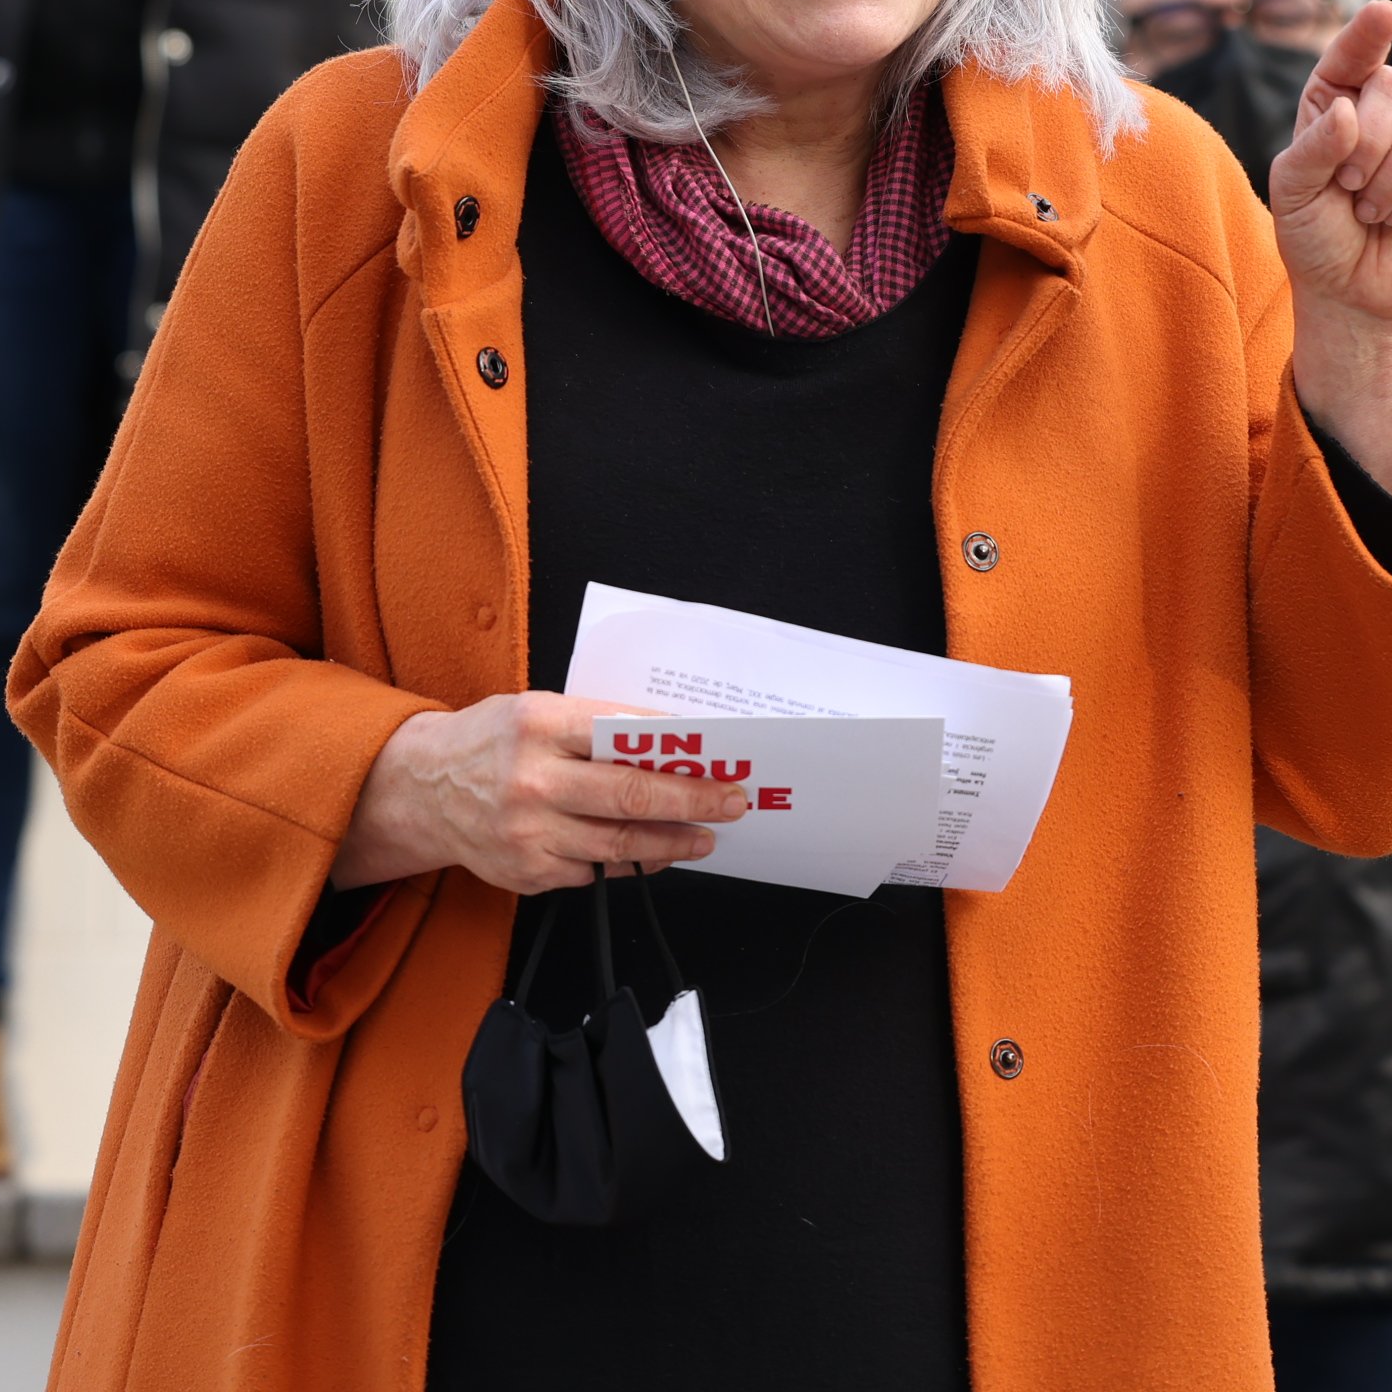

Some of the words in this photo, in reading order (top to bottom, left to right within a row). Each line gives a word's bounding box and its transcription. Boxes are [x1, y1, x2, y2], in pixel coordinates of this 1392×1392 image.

[664, 669, 676, 677] ser
[691, 674, 709, 685] 2020
[672, 692, 686, 700] que
[613, 733, 702, 755] UN
